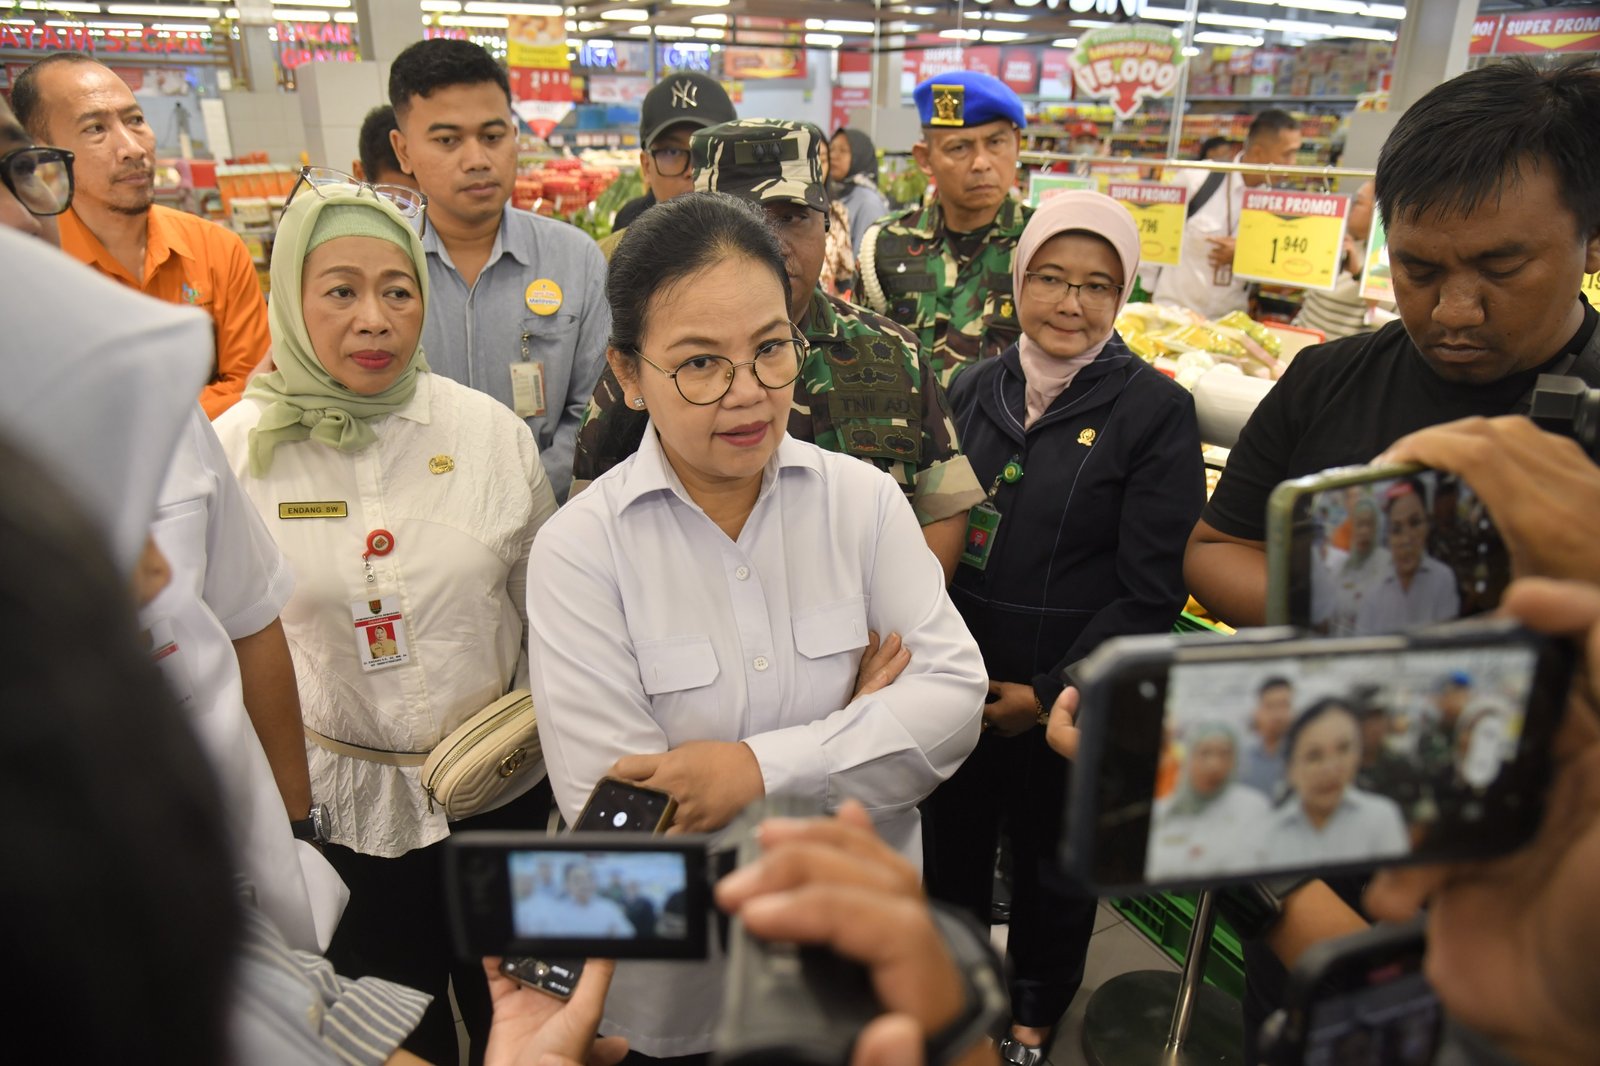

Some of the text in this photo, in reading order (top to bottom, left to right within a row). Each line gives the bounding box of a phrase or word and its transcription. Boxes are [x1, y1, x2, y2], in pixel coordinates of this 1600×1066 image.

[0, 24, 206, 54] AYAM SEGAR
[1506, 20, 1552, 35] SUPER
[1081, 55, 1174, 91] 15.000
[671, 79, 698, 109] NY
[1111, 186, 1181, 203] SUPER PROMO!
[1247, 194, 1338, 216] SUPER PROMO!
